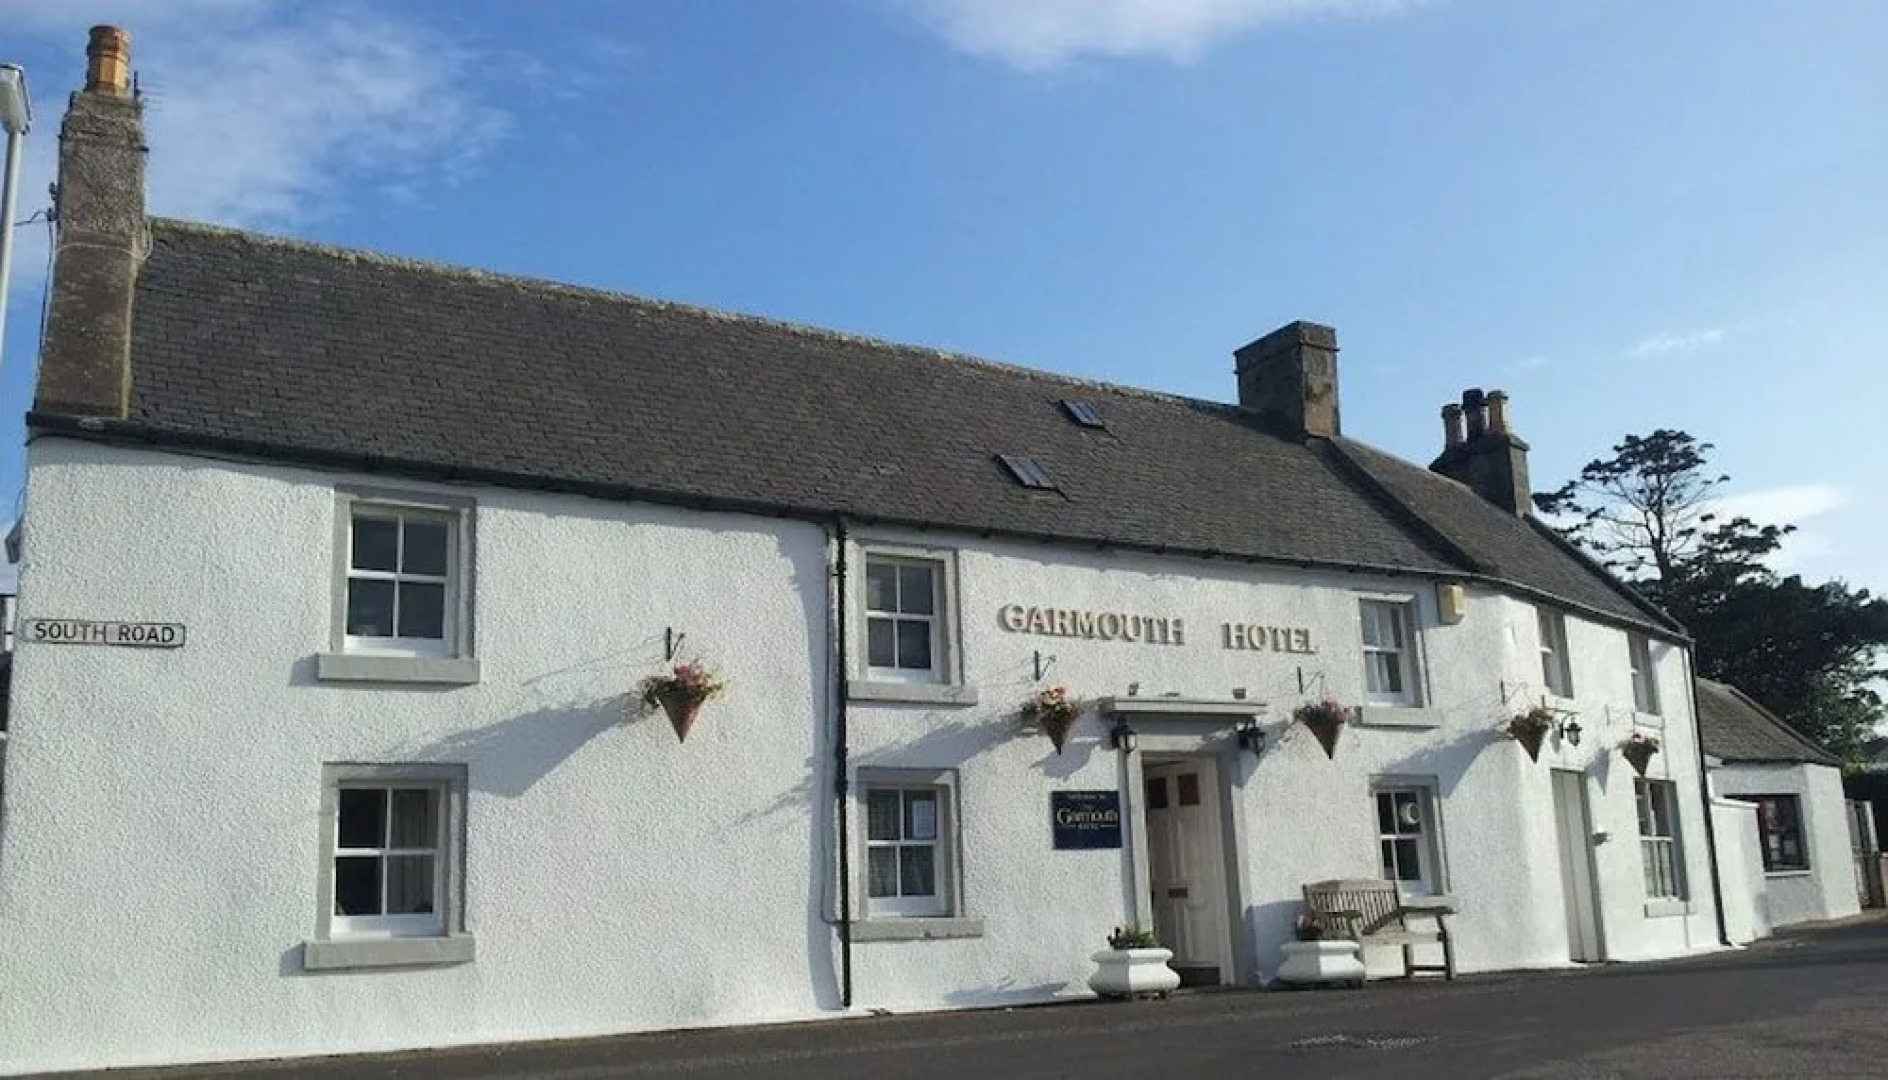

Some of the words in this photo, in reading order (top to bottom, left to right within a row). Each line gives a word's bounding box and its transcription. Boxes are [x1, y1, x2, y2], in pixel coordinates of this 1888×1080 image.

[35, 622, 106, 641] SOUTH
[118, 624, 175, 643] ROAD
[997, 603, 1185, 646] GARMOUTH
[1221, 622, 1319, 655] HOTEL
